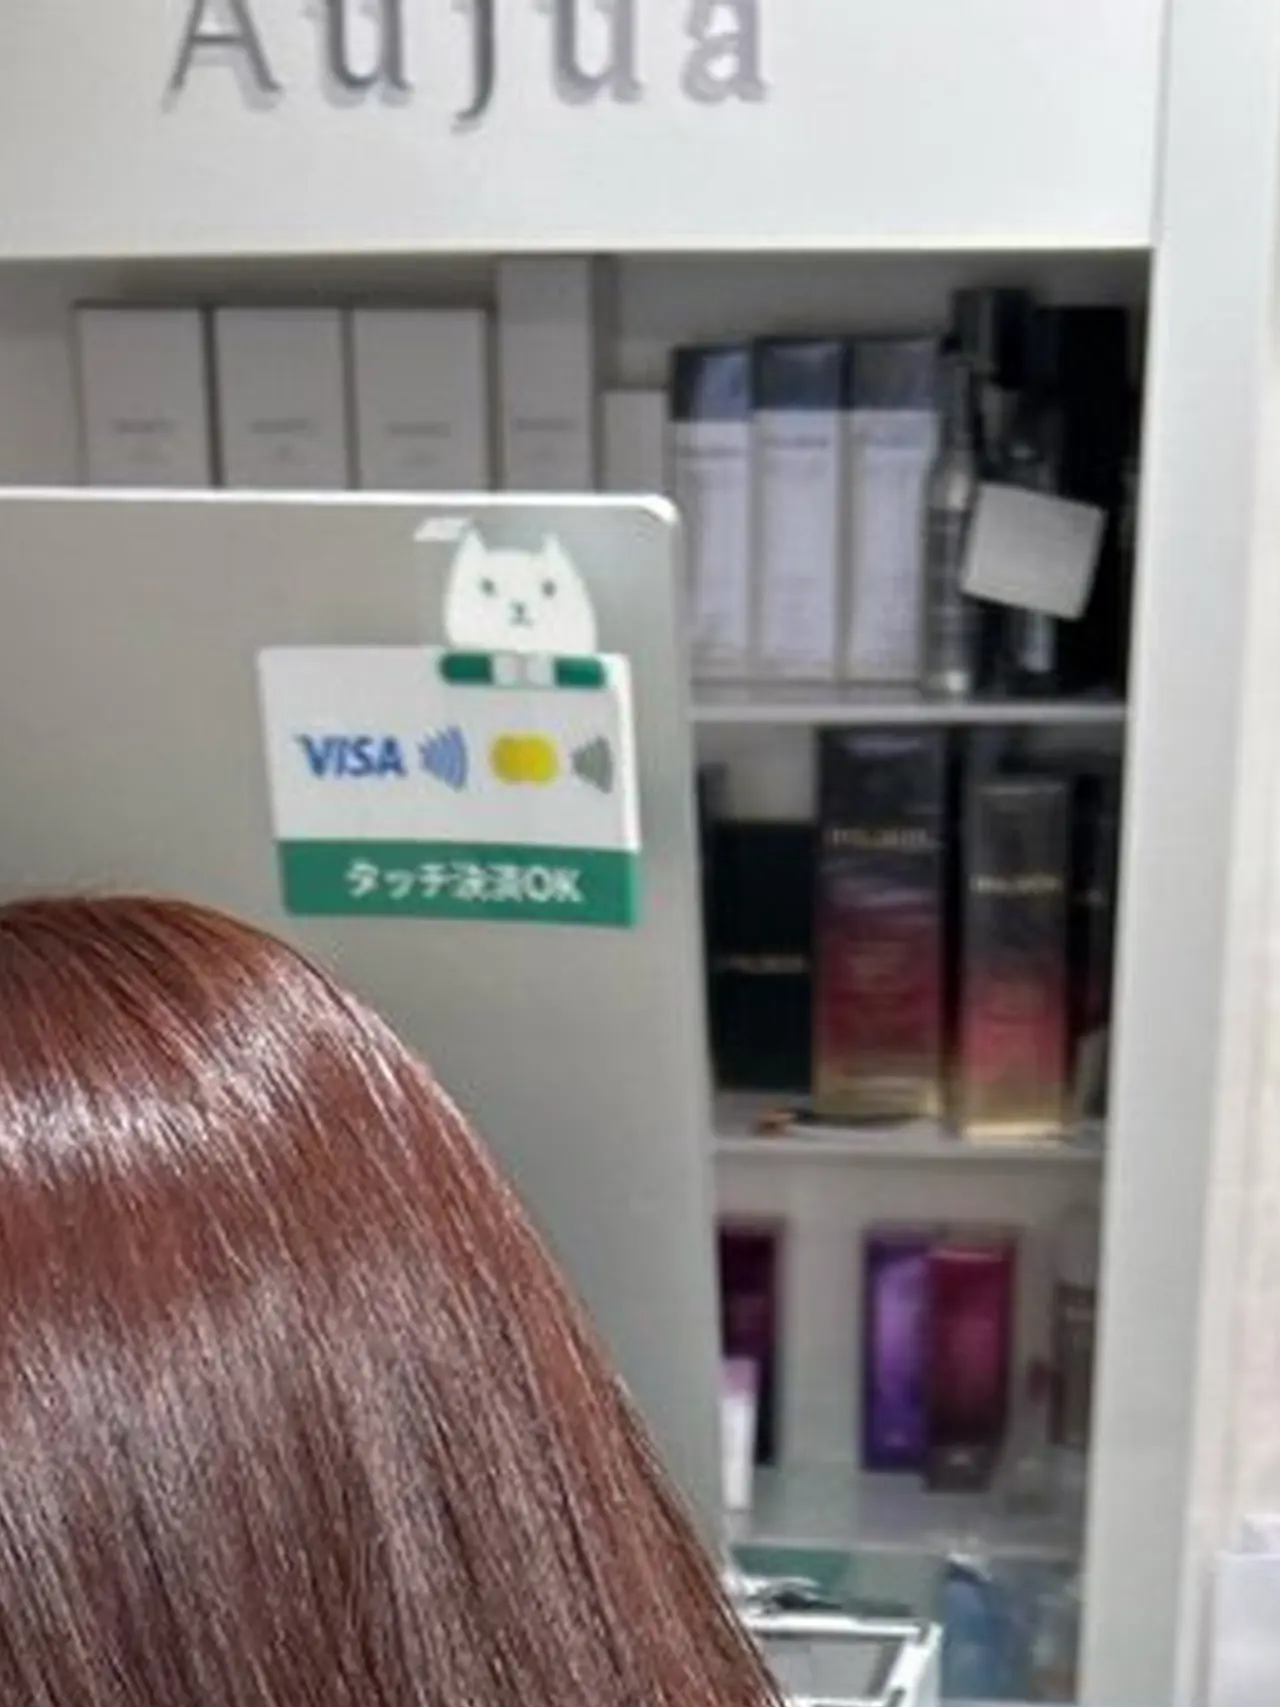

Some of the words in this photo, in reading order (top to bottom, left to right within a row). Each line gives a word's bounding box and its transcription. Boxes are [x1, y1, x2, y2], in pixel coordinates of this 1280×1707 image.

[297, 734, 407, 780] VISA
[345, 856, 584, 904] タッチ決済OK
